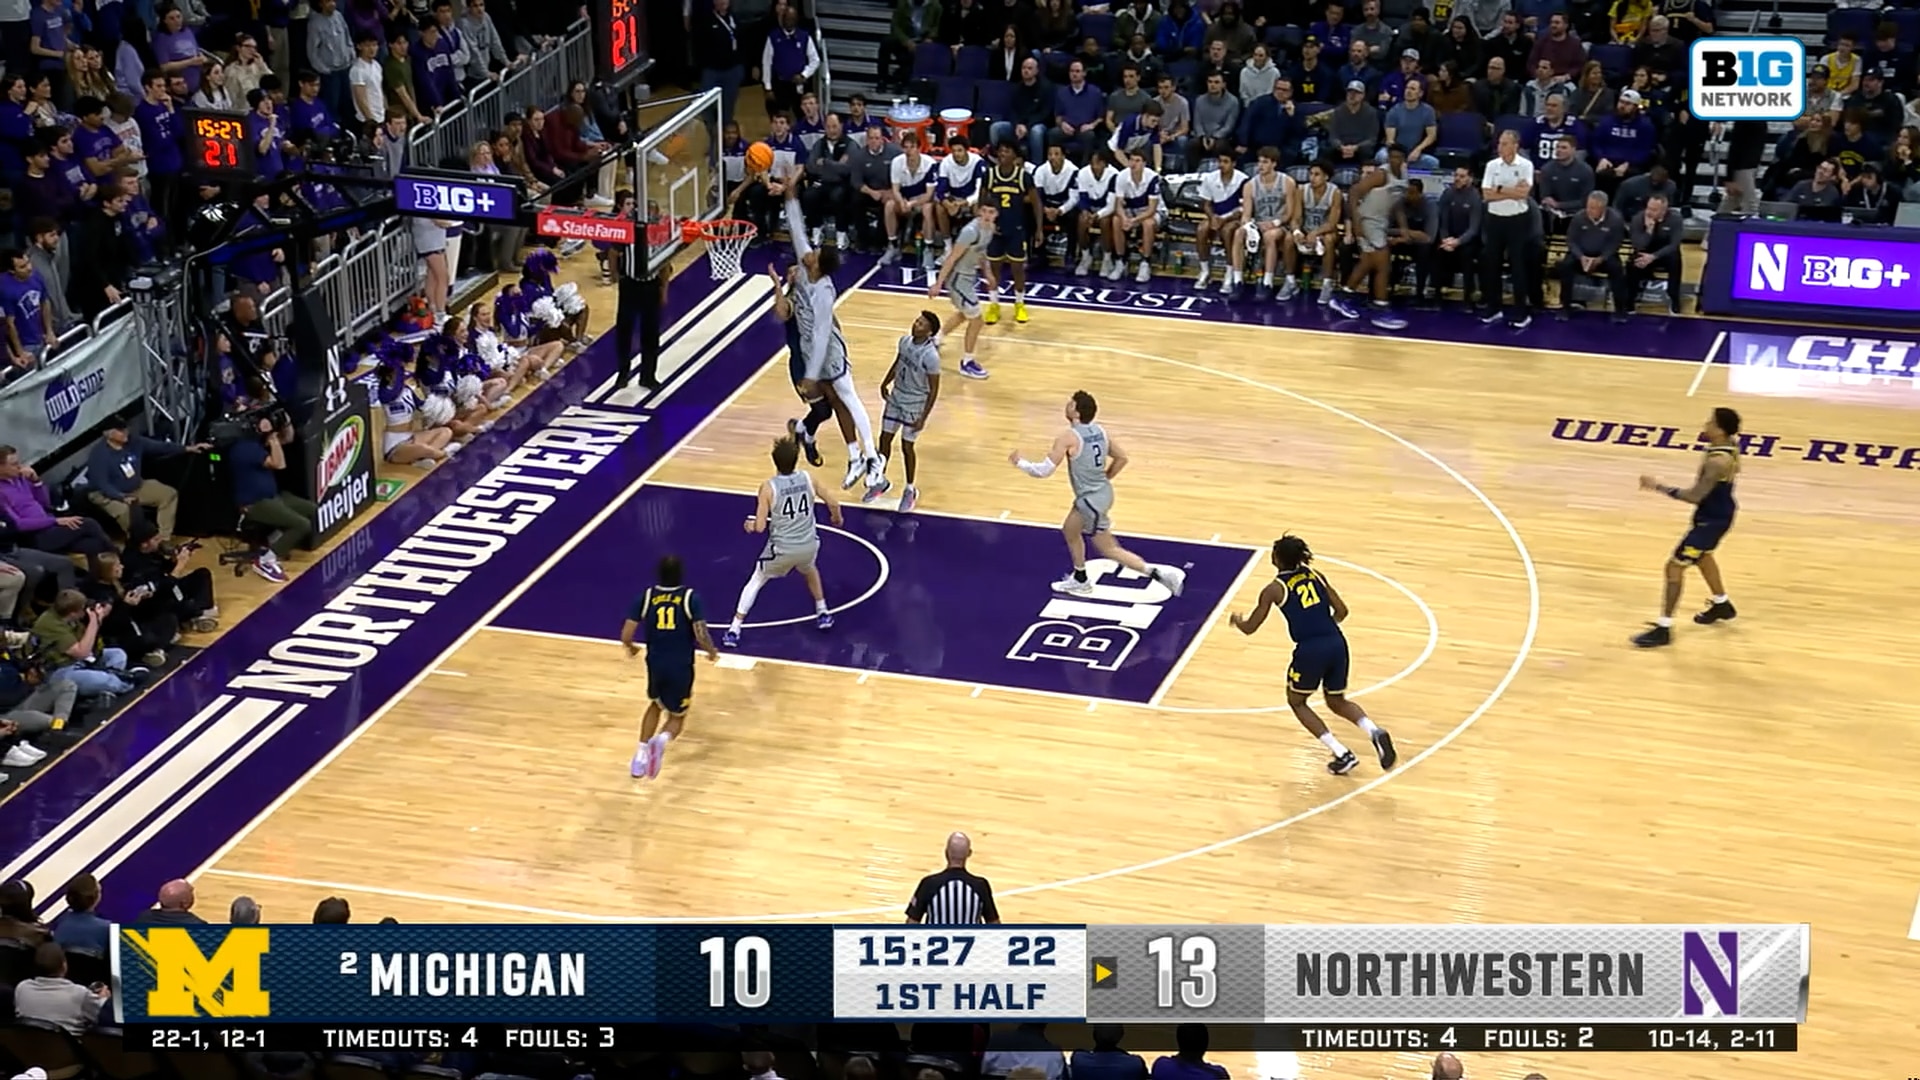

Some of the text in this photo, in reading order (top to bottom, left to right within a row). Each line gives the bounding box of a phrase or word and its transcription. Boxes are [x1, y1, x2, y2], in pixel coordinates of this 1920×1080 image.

[612, 15, 638, 68] 21
[197, 118, 243, 139] 15:27
[204, 139, 237, 167] 21
[1000, 193, 1011, 208] 2
[1750, 242, 1789, 292] N
[900, 266, 1212, 312] WTRUST
[327, 344, 341, 383] N
[1786, 334, 1920, 374] CH
[317, 424, 359, 503] LIBMAN
[1092, 444, 1102, 467] 2
[318, 470, 370, 533] meijer
[782, 493, 809, 520] 44
[226, 405, 651, 699] NORTHWESTERN
[1296, 581, 1321, 609] 21
[656, 606, 676, 630] 11
